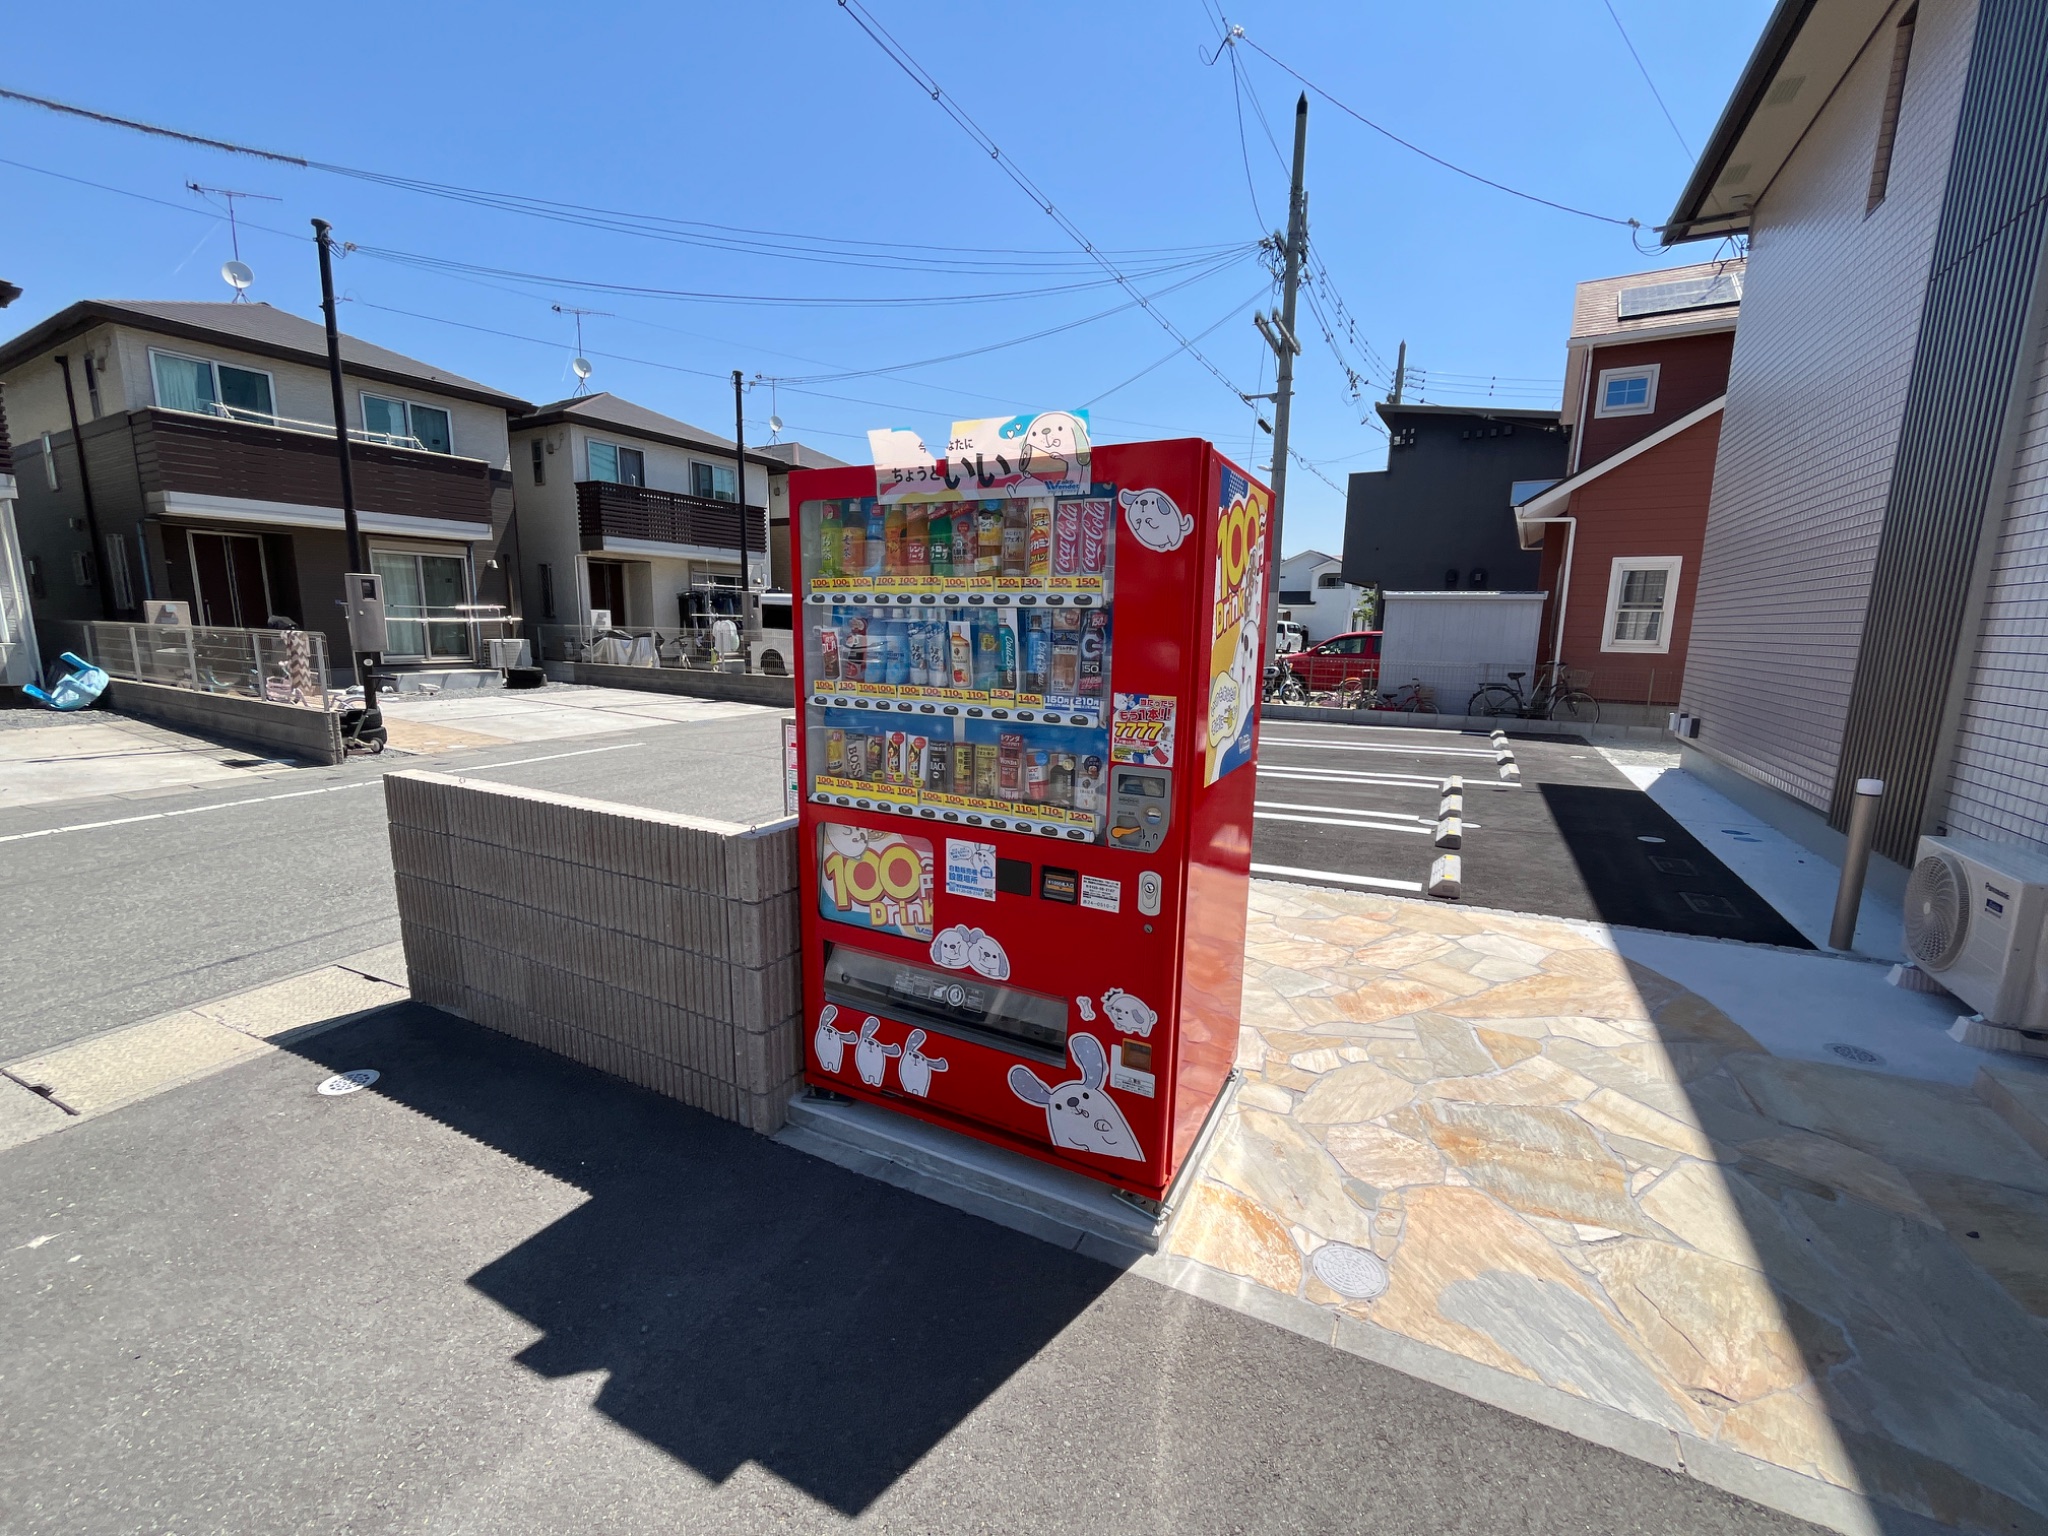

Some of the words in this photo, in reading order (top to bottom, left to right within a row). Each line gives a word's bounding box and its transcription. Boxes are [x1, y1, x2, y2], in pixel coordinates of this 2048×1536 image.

[1055, 503, 1079, 574] Coca-Cola
[1082, 502, 1106, 573] Coca-Cola
[1140, 698, 1175, 708] 当たったら
[1115, 721, 1165, 740] 7777
[848, 745, 863, 777] BOSS
